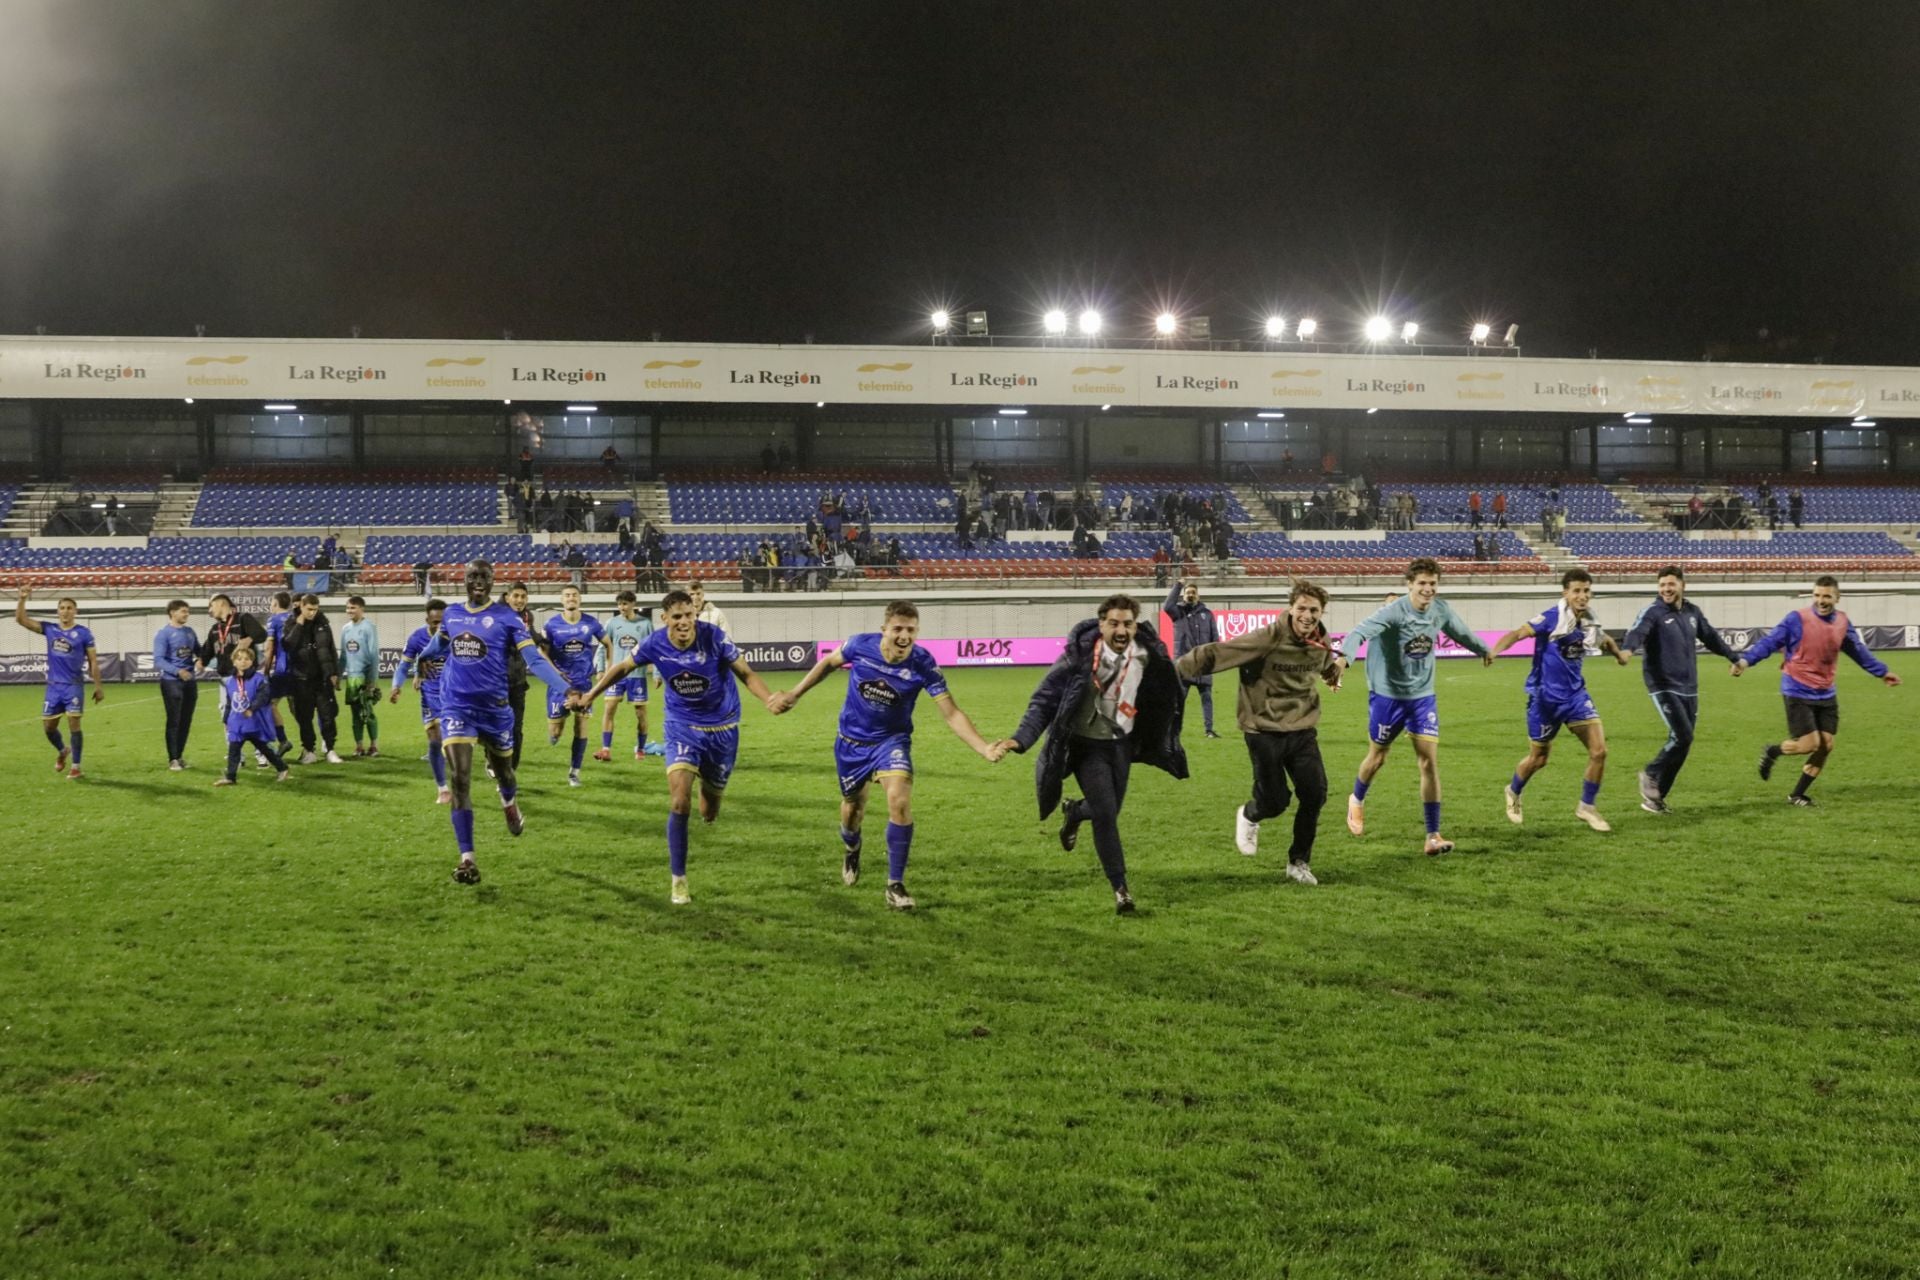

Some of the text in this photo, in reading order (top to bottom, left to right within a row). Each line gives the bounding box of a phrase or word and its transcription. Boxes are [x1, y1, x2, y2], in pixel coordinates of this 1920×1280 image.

[45, 363, 71, 378] La
[289, 365, 315, 380] La
[512, 367, 537, 382] La
[730, 370, 754, 384] La
[950, 373, 974, 386] La
[1156, 375, 1178, 389] La
[1346, 378, 1368, 392] La
[453, 640, 481, 650] Estrella
[455, 647, 480, 656] Galicia
[957, 639, 1013, 657] LAZOS
[738, 646, 784, 662] alicia
